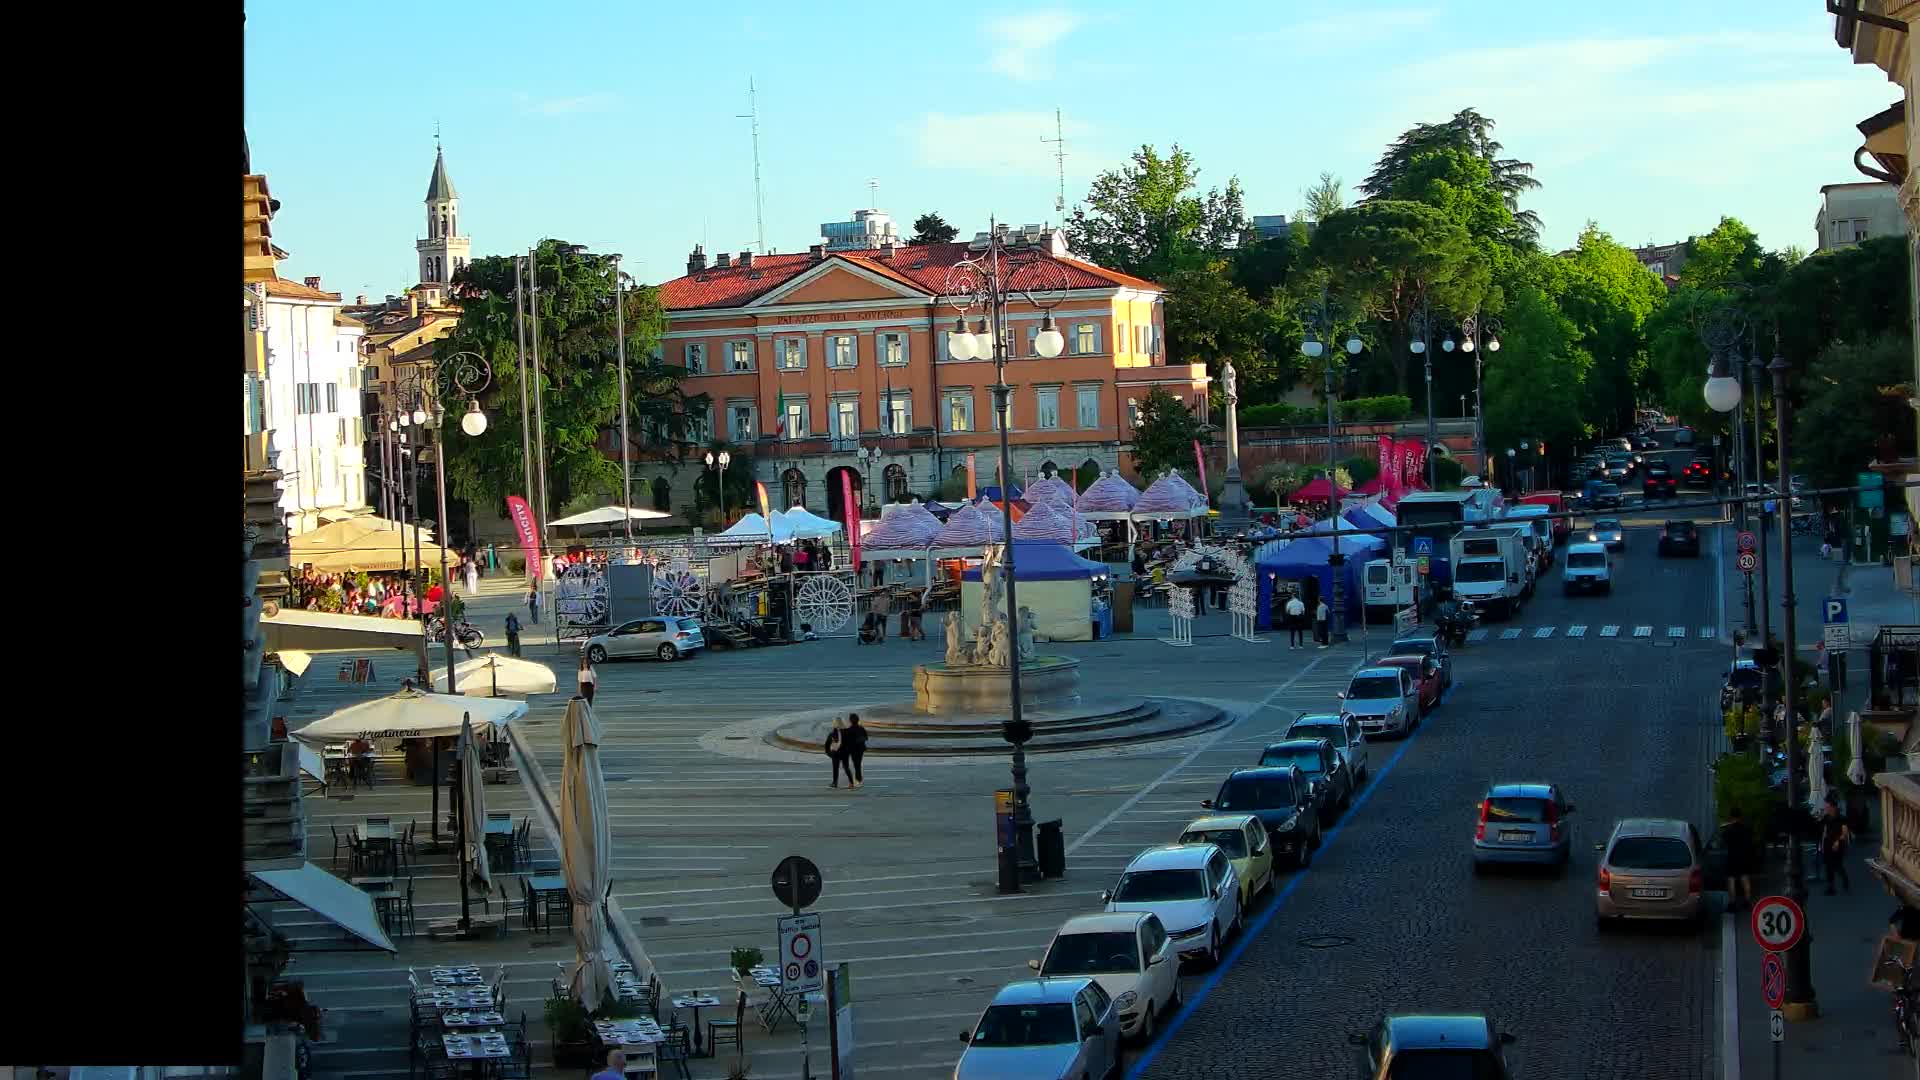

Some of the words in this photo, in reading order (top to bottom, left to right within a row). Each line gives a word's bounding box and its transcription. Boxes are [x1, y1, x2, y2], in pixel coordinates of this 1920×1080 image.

[1742, 557, 1753, 566] 20
[1827, 601, 1843, 622] P
[1762, 910, 1792, 937] 30
